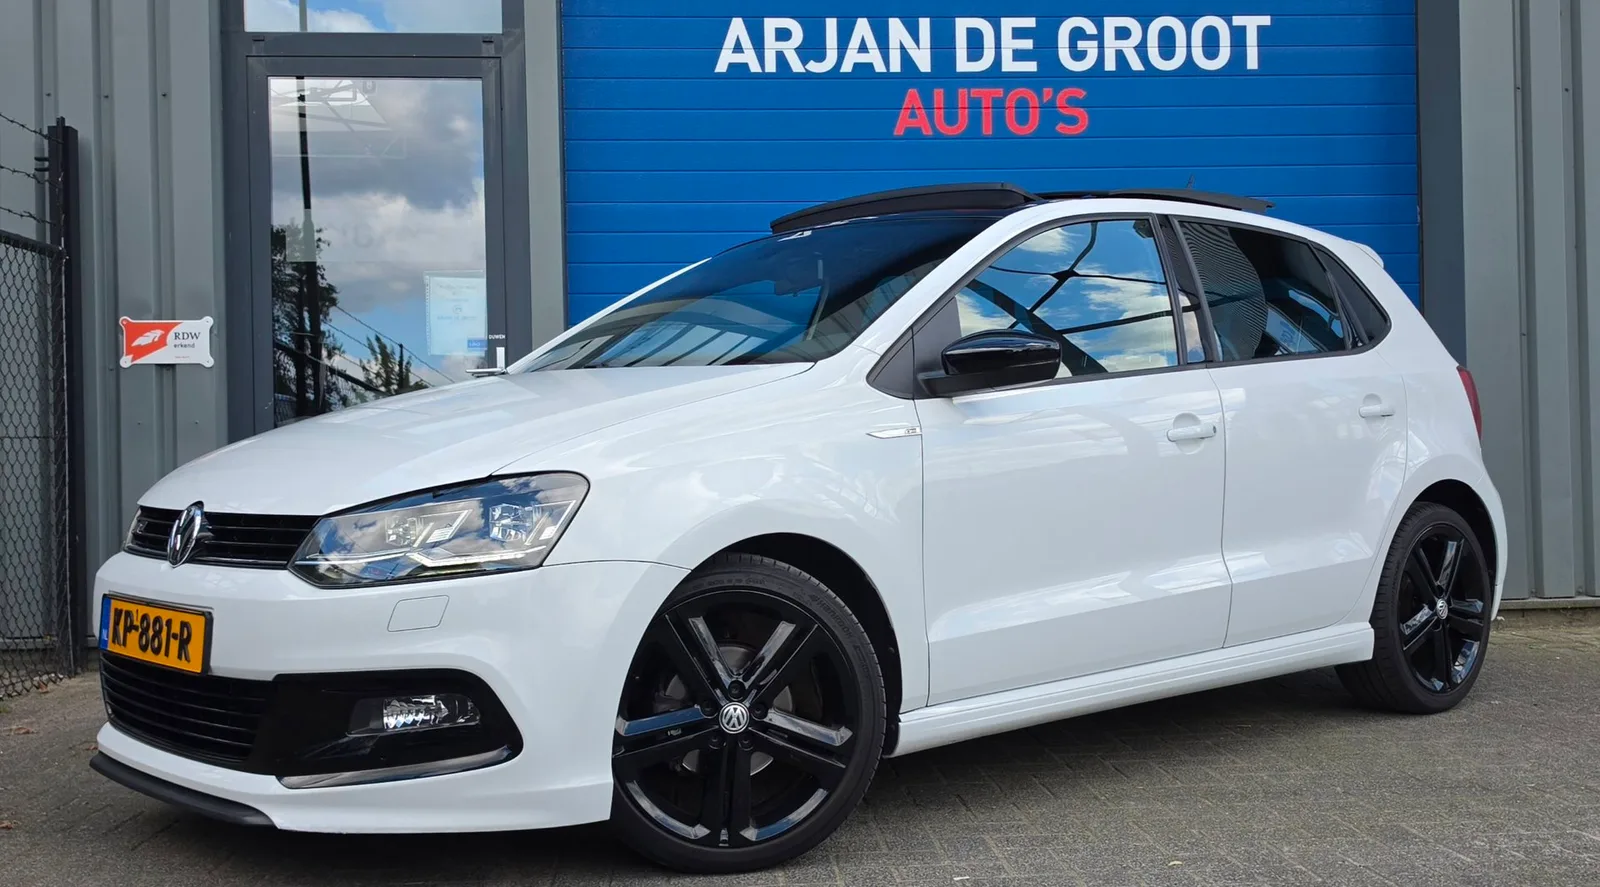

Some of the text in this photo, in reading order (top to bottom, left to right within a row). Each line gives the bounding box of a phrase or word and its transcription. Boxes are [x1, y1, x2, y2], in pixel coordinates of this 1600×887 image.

[715, 15, 1271, 73] ARJAN DE GROOT
[894, 87, 1090, 136] AUTO'S
[174, 331, 201, 341] RDW
[111, 607, 193, 663] KP-881-R
